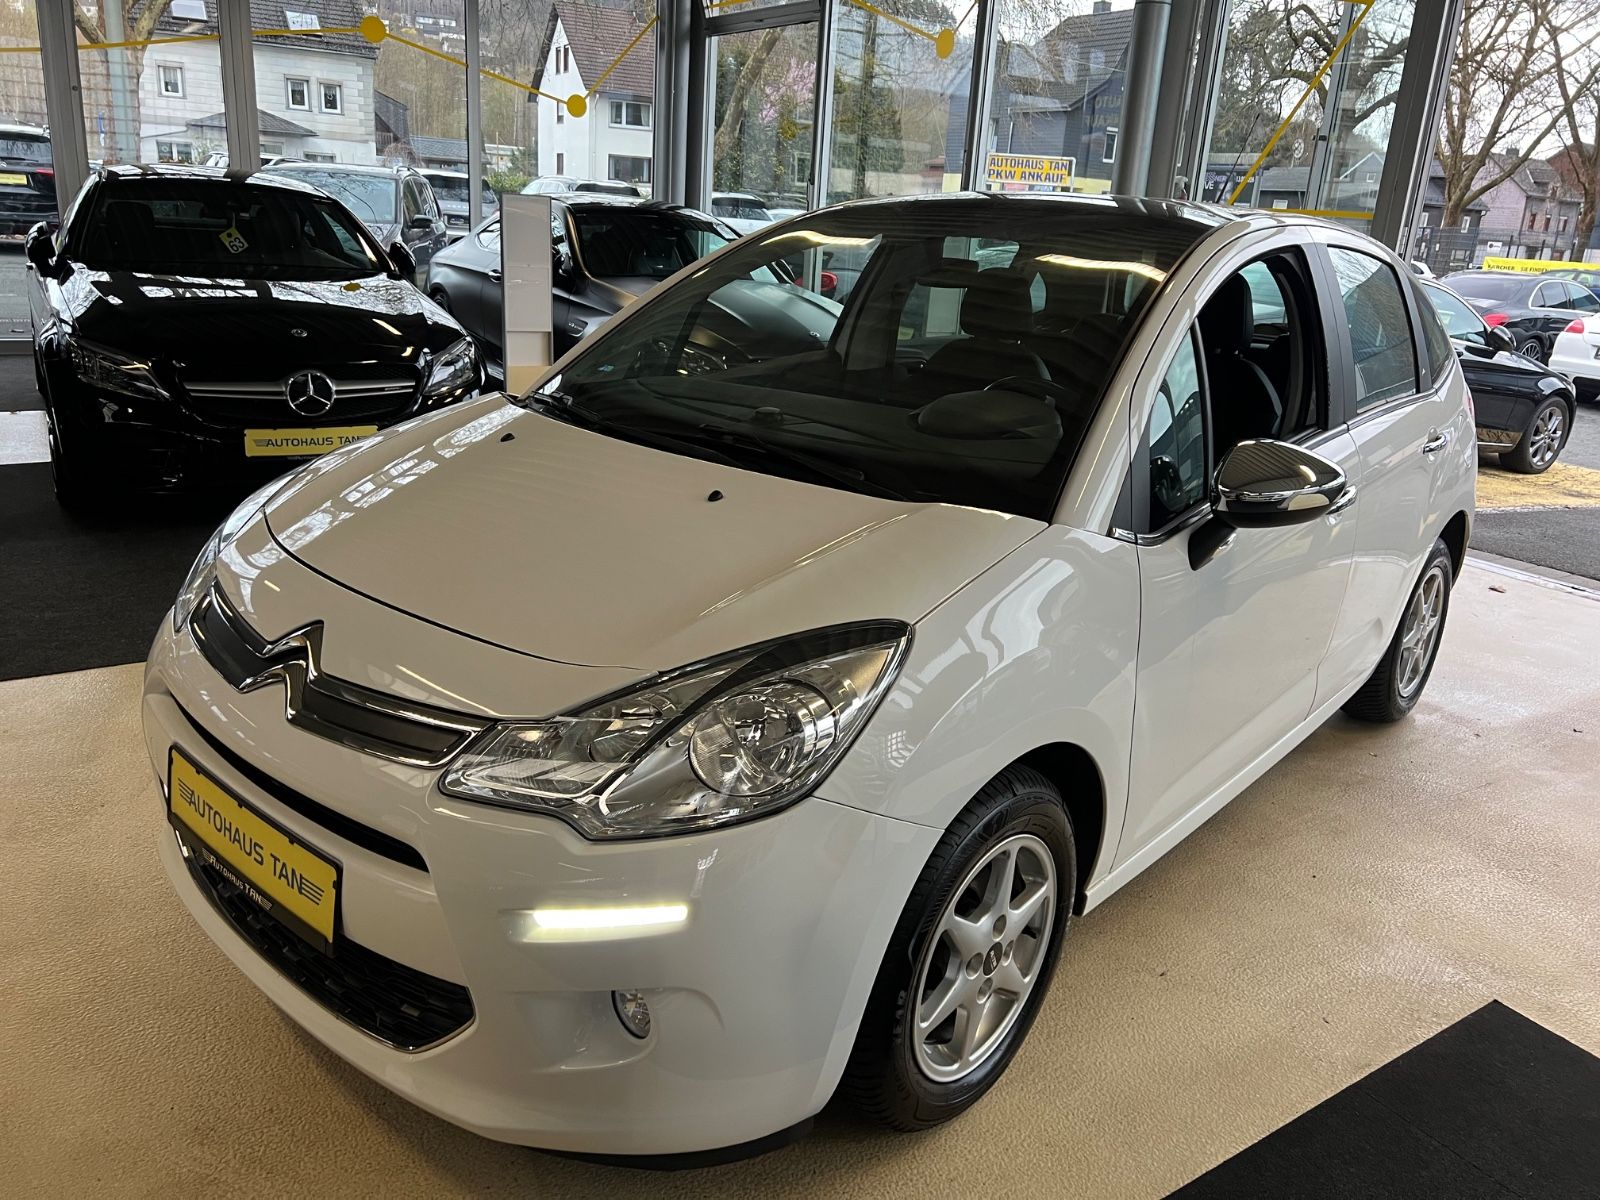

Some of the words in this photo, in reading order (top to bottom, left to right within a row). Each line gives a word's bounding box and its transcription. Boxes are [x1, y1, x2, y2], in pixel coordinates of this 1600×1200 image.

[990, 157, 1044, 170] AUTOHAUS
[1049, 160, 1068, 171] TAN
[988, 169, 1016, 180] PKW
[1020, 171, 1067, 183] ANKAUF
[229, 237, 244, 251] 63
[266, 437, 333, 447] AUTOHAUS
[189, 790, 264, 866] AUTOHAUS
[270, 853, 304, 895] TAN
[210, 856, 244, 889] AUTOHAUS
[244, 883, 262, 904] TAN
